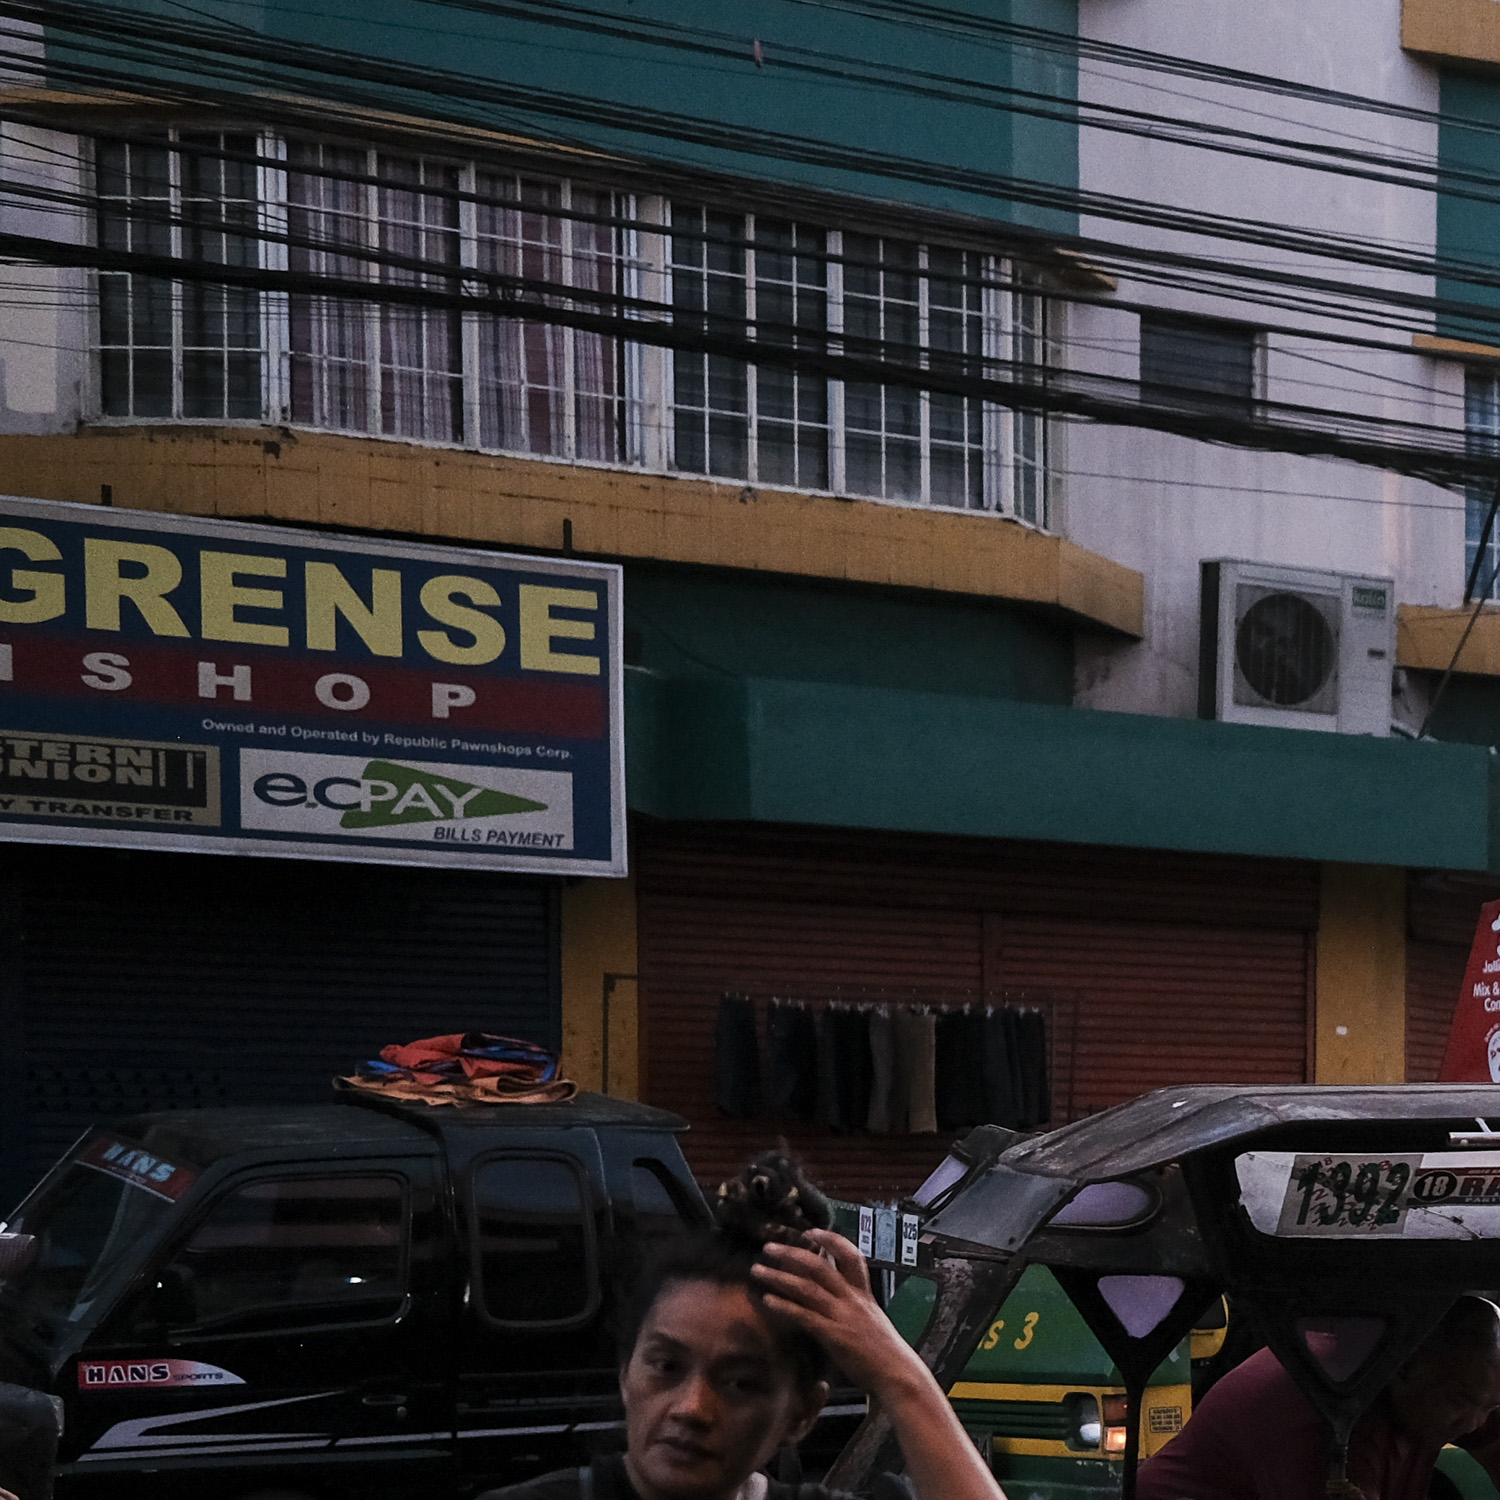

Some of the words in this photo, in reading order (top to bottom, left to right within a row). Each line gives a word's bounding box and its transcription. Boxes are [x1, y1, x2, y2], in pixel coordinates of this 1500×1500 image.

[0, 643, 477, 719] SHOP
[0, 737, 152, 767] TERN
[202, 719, 255, 734] Owned
[258, 725, 287, 736] and
[291, 726, 358, 742] Operated
[362, 732, 380, 745] by
[384, 733, 447, 749] Republic
[451, 739, 532, 757] Pawnshops
[536, 746, 573, 760] Corp.
[0, 758, 153, 787] NION
[27, 800, 193, 822] TRANSFER
[433, 826, 484, 843] BILLS
[486, 829, 565, 848] PAYMENT
[1473, 981, 1491, 997] Mix
[1492, 981, 1500, 996] &
[1420, 1176, 1450, 1198] 18
[977, 1319, 1005, 1350] S
[1013, 1311, 1040, 1350] 3
[85, 1364, 170, 1385] HANS
